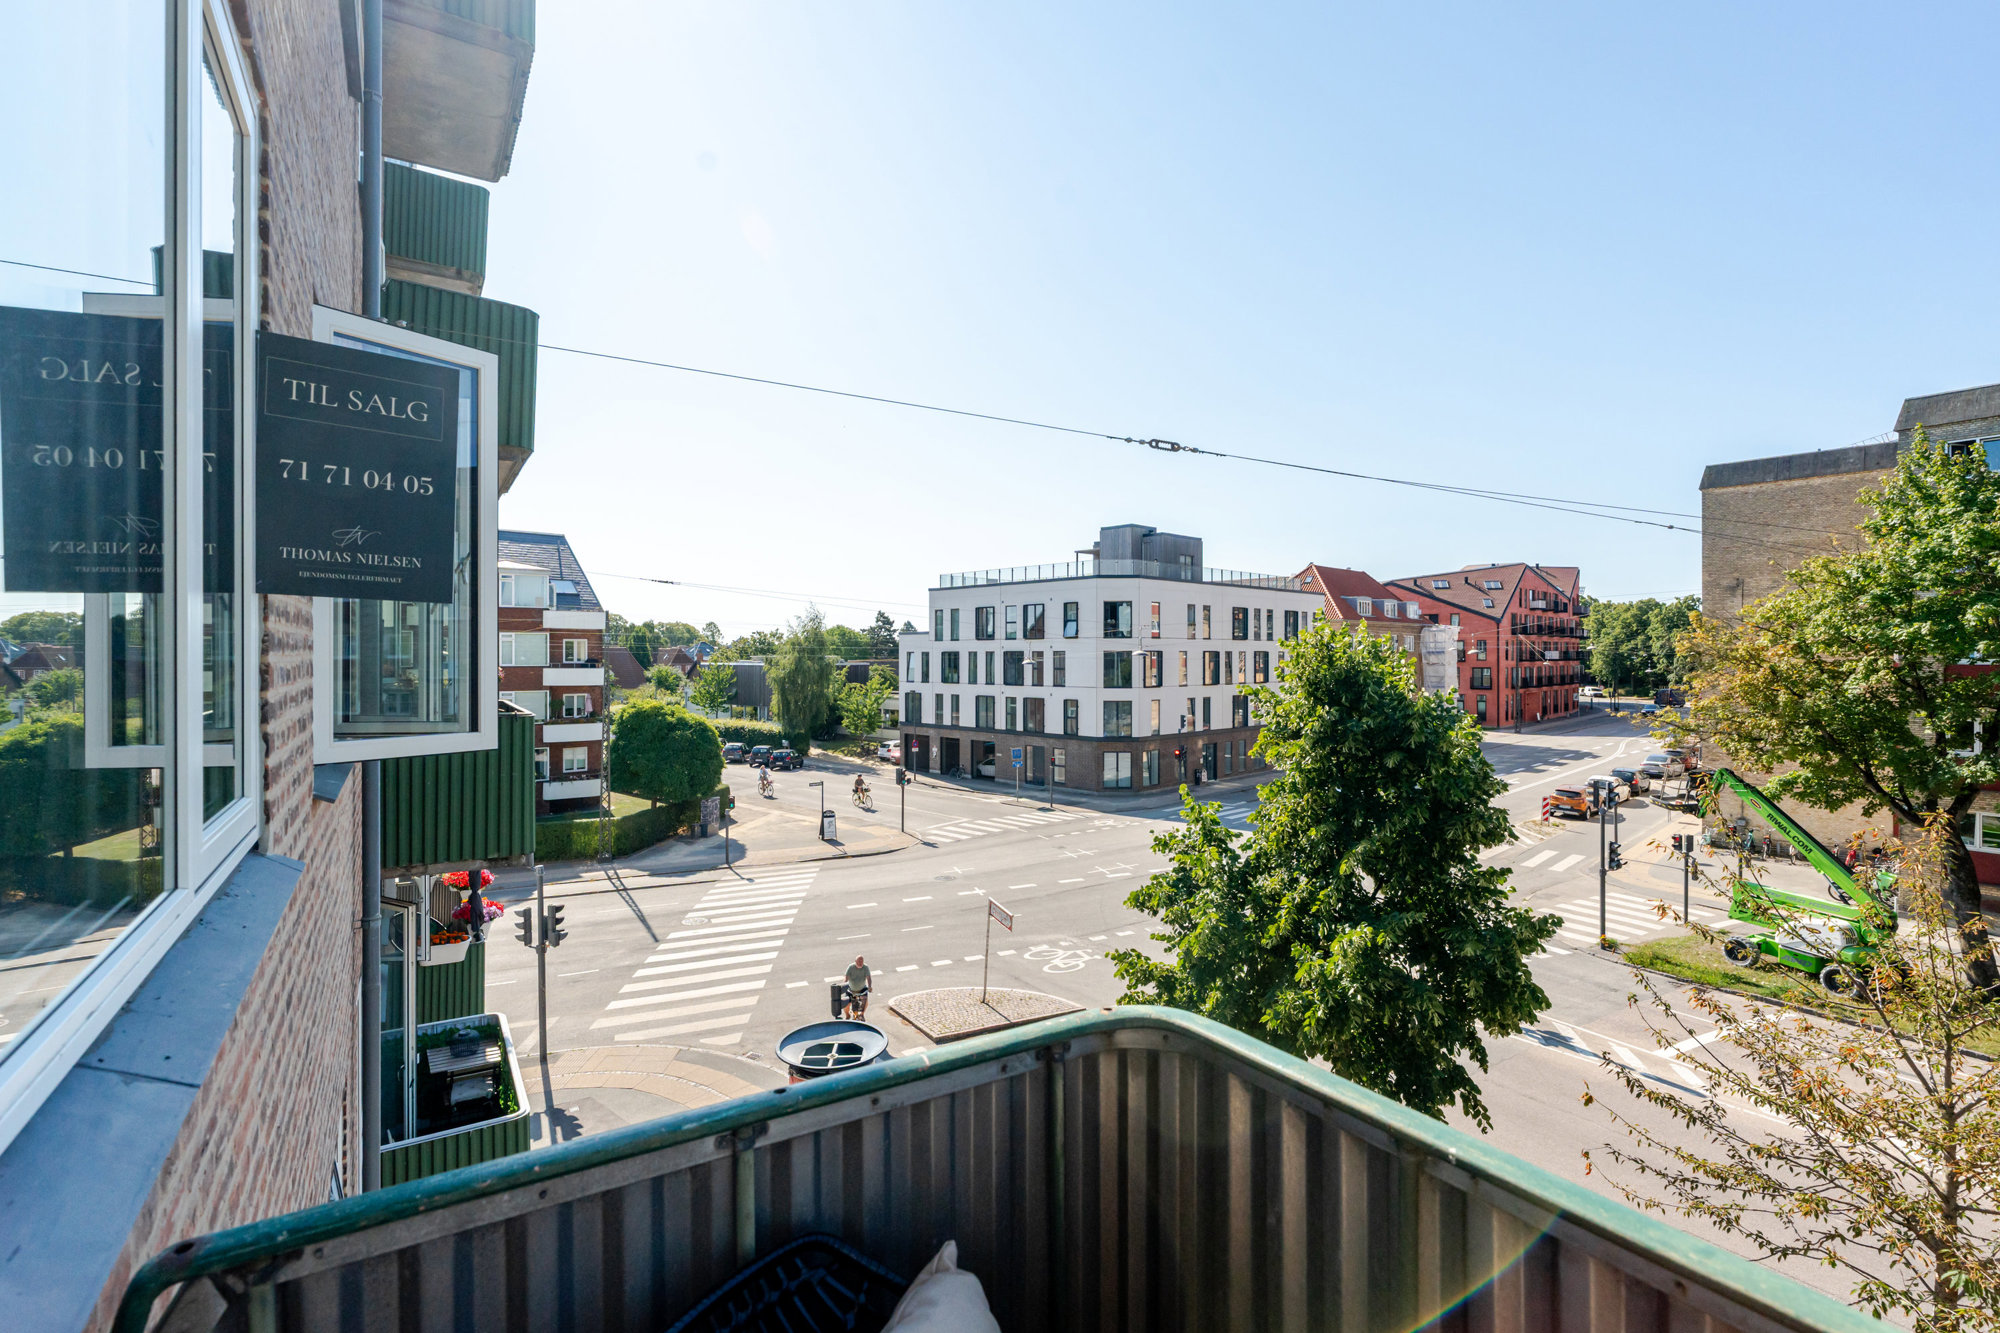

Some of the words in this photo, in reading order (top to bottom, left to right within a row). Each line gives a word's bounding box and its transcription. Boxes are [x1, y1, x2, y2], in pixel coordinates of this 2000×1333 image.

[283, 378, 338, 407] TIL
[348, 390, 428, 422] SALG
[279, 459, 309, 481] 71
[323, 465, 352, 486] 71
[363, 470, 395, 491] 04
[403, 475, 434, 496] 05
[280, 546, 351, 563] THOMAS
[356, 552, 422, 568] NIELSEN
